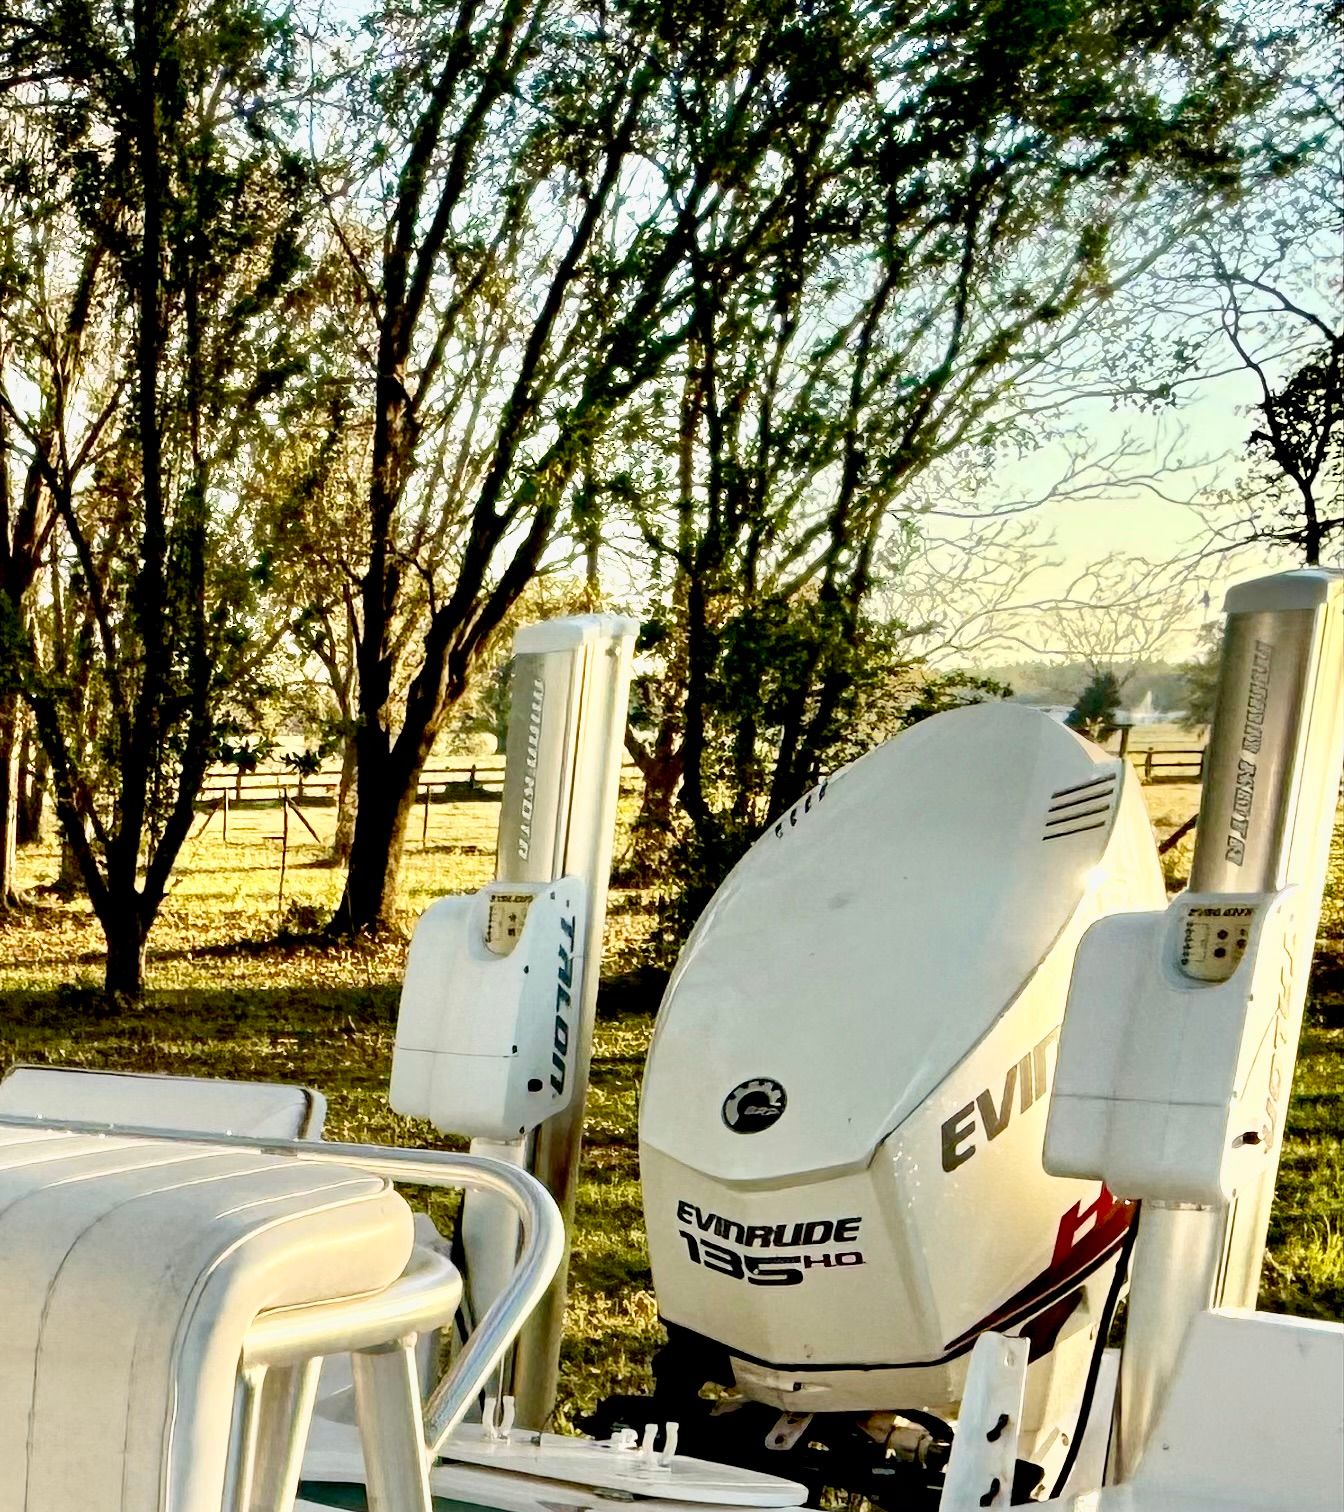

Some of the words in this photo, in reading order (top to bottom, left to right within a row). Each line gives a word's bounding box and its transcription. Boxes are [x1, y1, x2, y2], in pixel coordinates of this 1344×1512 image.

[1225, 758, 1257, 867] KOTA
[550, 915, 576, 1096] TALON
[676, 1199, 863, 1248] EVINRUDE
[678, 1229, 804, 1286] 135
